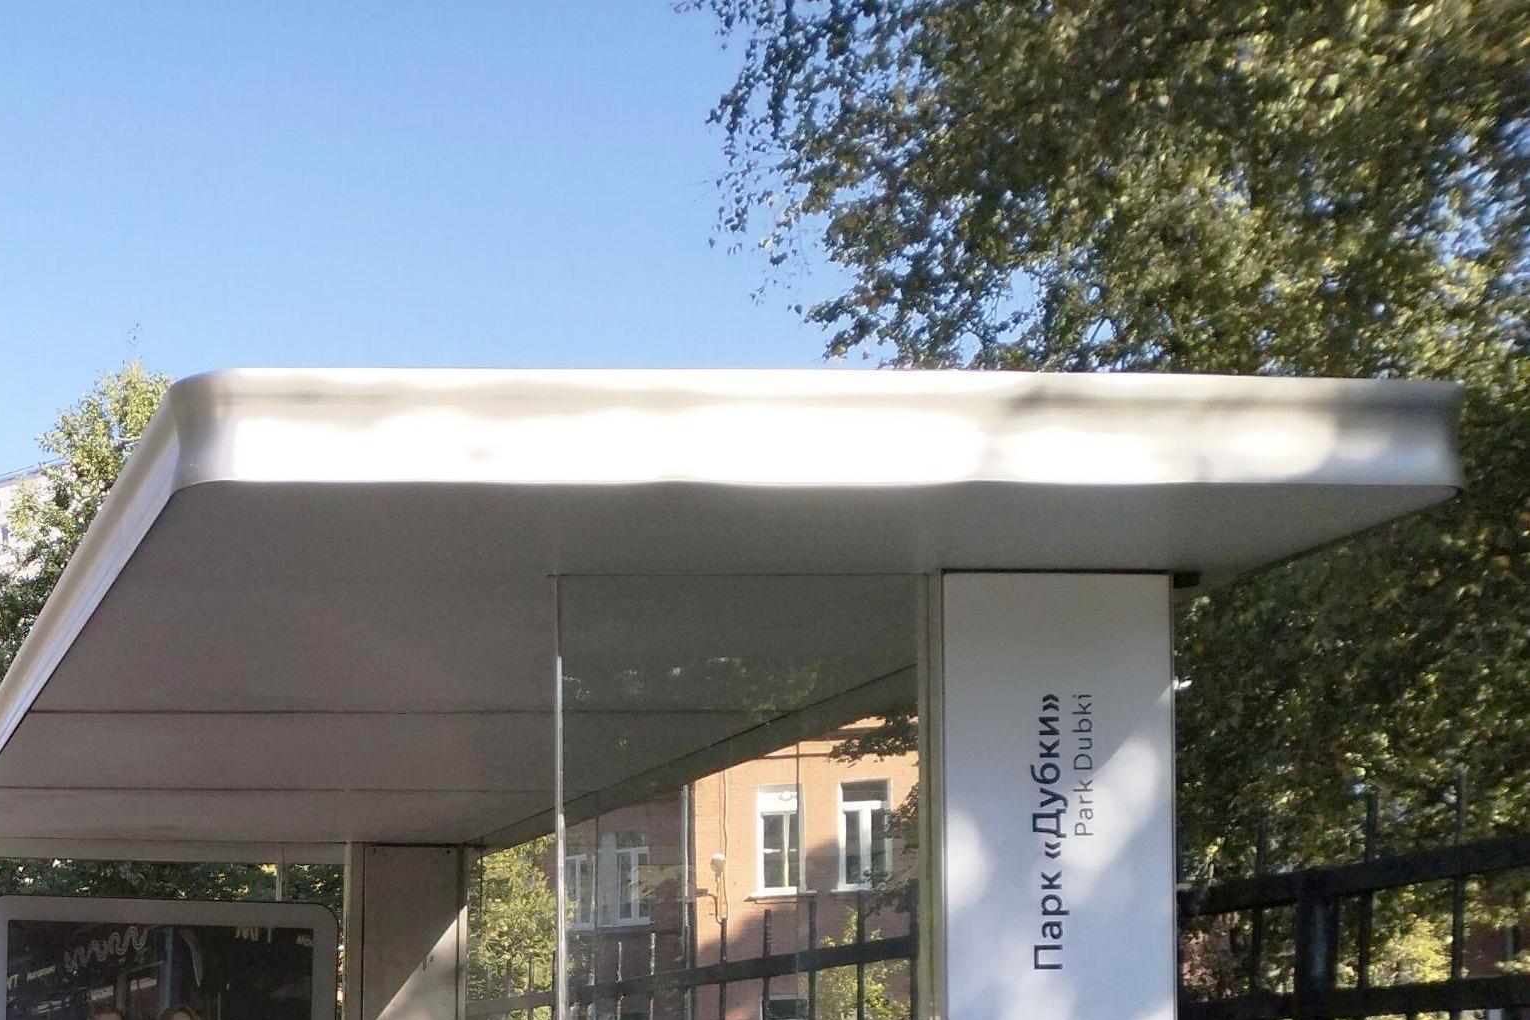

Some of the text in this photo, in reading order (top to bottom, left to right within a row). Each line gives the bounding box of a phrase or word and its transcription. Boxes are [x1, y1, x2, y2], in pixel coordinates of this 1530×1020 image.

[1030, 693, 1070, 971] Парк «Дубки»
[1072, 693, 1094, 837] Park Dubki
